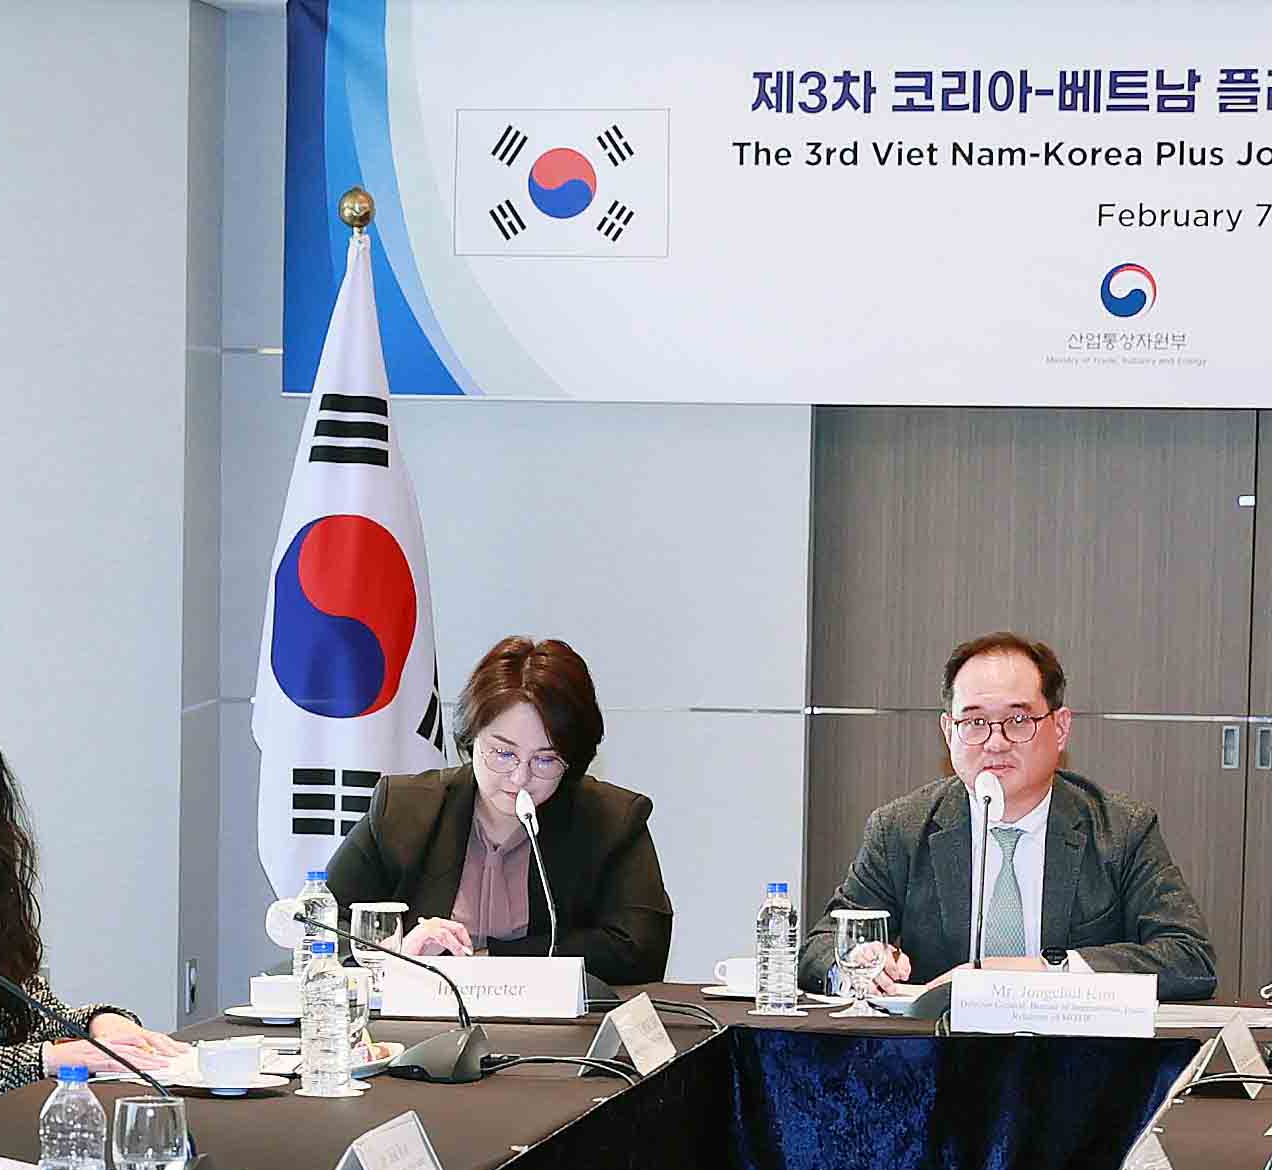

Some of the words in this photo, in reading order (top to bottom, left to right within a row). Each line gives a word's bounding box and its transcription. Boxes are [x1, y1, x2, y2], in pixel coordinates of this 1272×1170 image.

[750, 68, 877, 115] 제3차
[890, 67, 1202, 114] 코리아-베트남
[731, 140, 792, 167] The
[804, 140, 859, 167] 3rd
[871, 140, 939, 167] Viet
[951, 140, 1142, 167] Nam-Korea
[1156, 140, 1224, 167] Plus
[1097, 202, 1243, 233] February
[1066, 330, 1187, 352] 산업통상자원부
[437, 980, 528, 1001] Inerpreter
